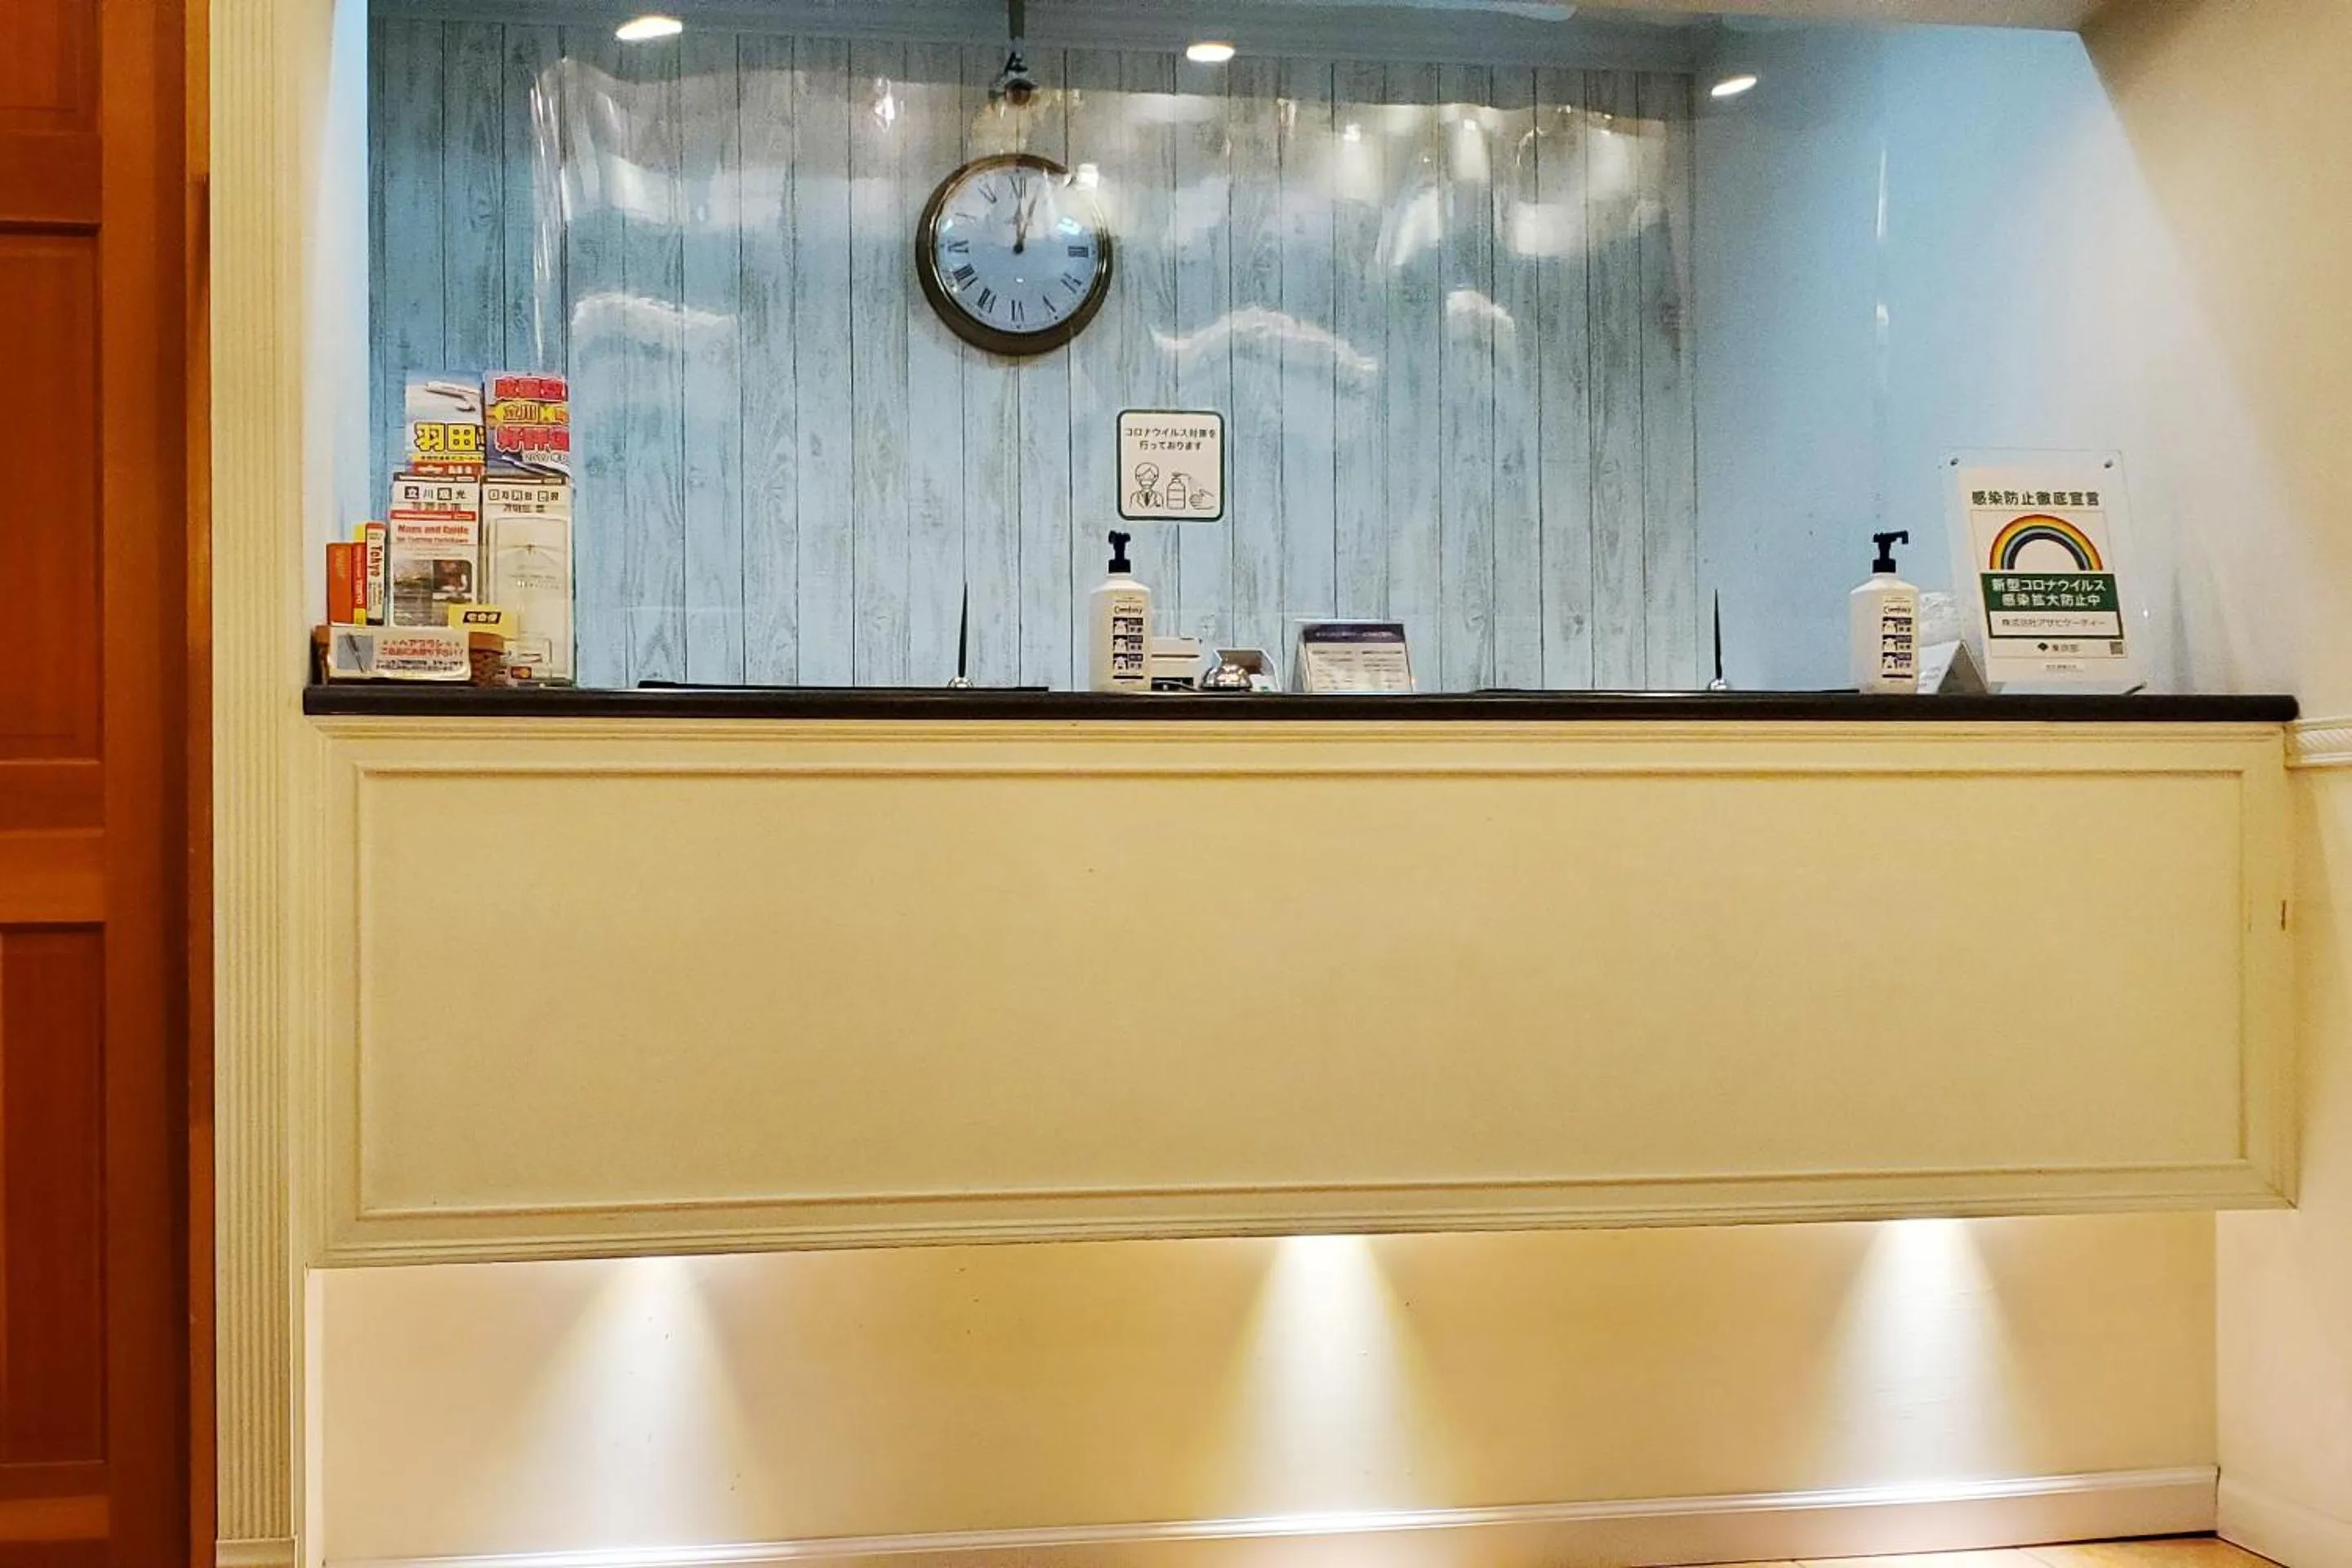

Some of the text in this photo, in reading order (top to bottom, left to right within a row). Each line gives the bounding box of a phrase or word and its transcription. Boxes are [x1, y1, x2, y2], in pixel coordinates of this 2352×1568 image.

[1124, 427, 1216, 439] コロナウイルス対策を
[1139, 440, 1201, 451] 行っております
[1971, 490, 2099, 506] 感染防止徹底宣言
[368, 545, 383, 577] Tokyo
[1992, 578, 2106, 591] 新型コロナウイルス
[2002, 593, 2100, 607] 感染拡大防止中
